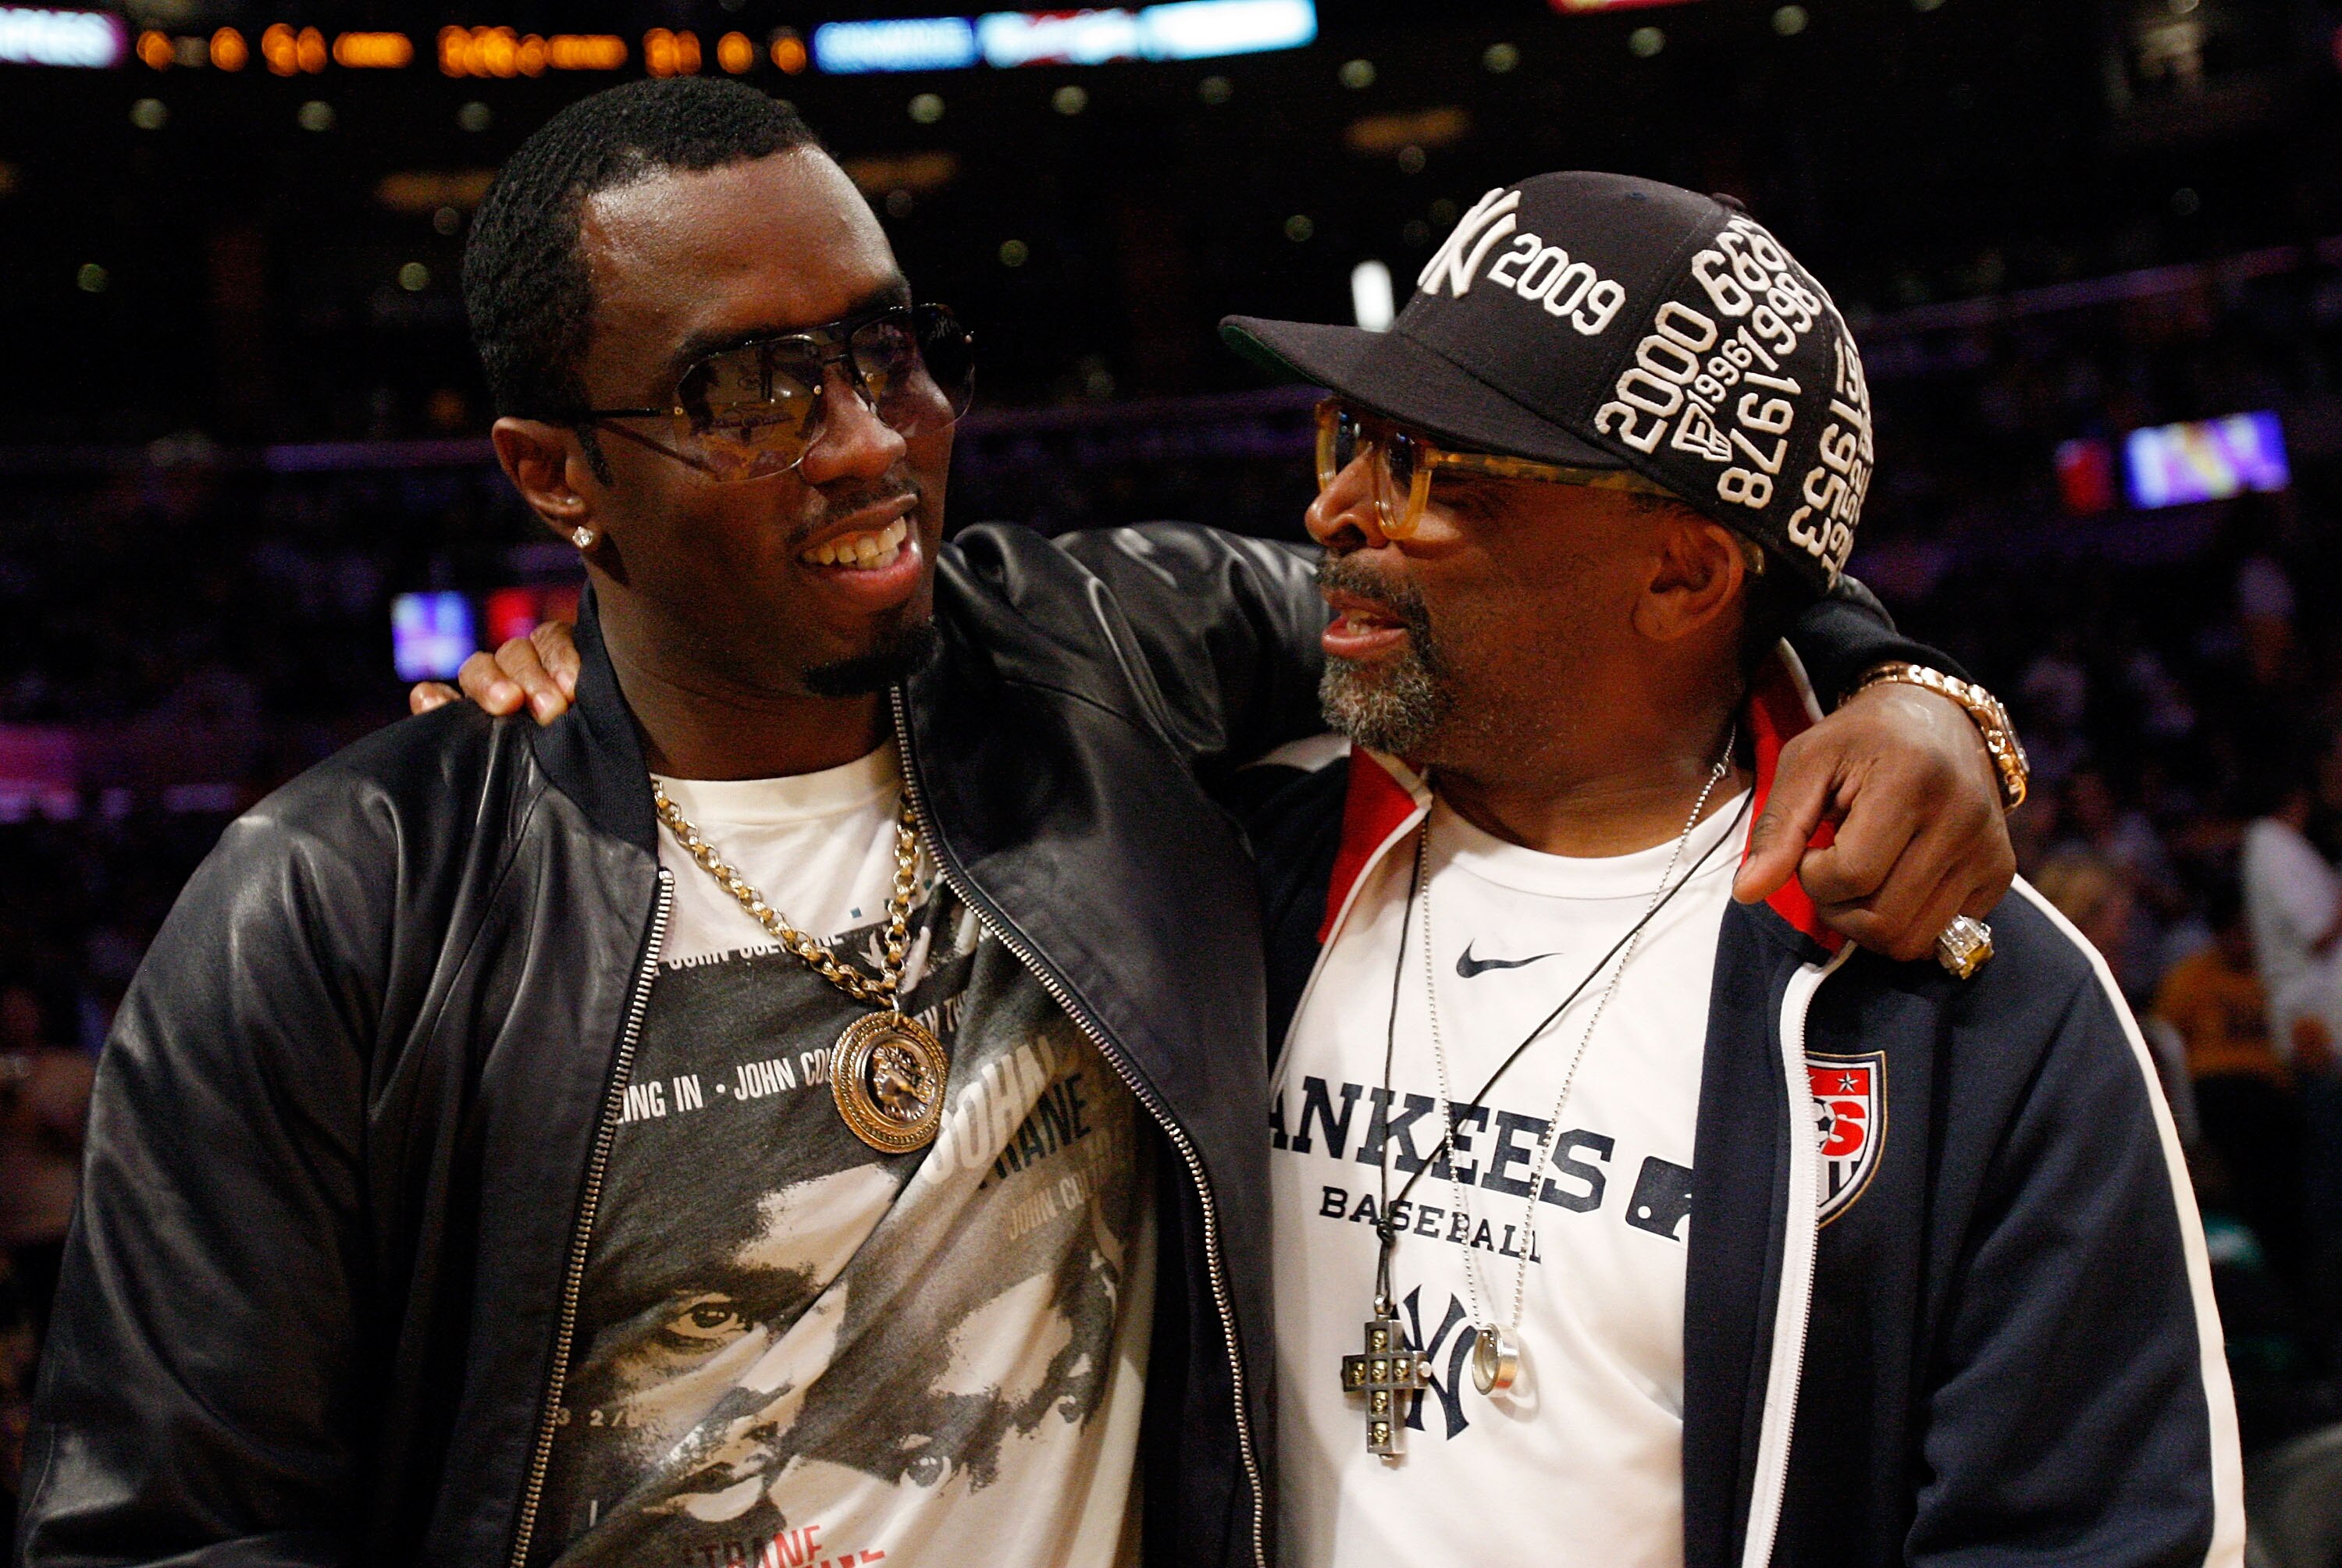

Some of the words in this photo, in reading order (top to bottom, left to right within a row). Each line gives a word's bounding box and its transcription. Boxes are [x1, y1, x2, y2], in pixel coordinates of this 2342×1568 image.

[1486, 233, 1626, 336] 2009
[1737, 272, 1823, 372] 1998
[1593, 300, 1718, 454] 2000
[1686, 339, 1753, 414] 1996
[1717, 371, 1802, 509] 1978
[1788, 398, 1863, 557] 1953
[618, 1081, 667, 1125] ING
[673, 1074, 703, 1112] IN
[733, 1058, 796, 1101] JOHN
[1268, 1076, 1616, 1214] ANKEES
